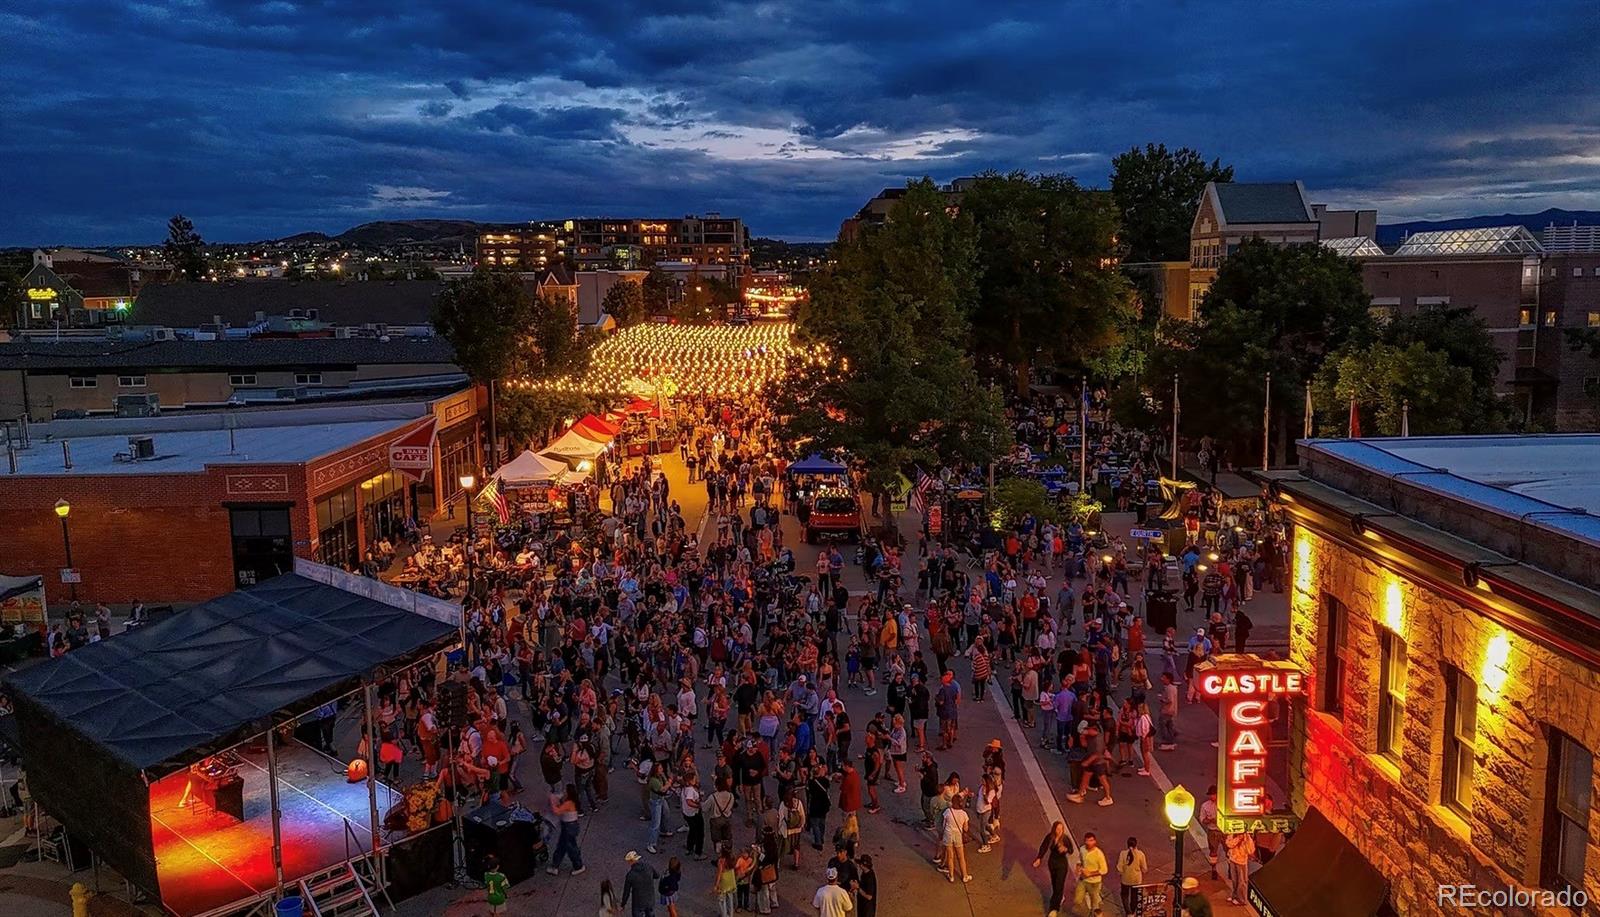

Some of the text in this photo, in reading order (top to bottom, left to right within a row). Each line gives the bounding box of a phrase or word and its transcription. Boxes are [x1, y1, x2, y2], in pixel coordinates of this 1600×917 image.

[393, 451, 427, 462] CAFE
[1204, 673, 1302, 695] CASTLE
[1230, 701, 1268, 814] CAFE
[1224, 818, 1291, 834] BAR
